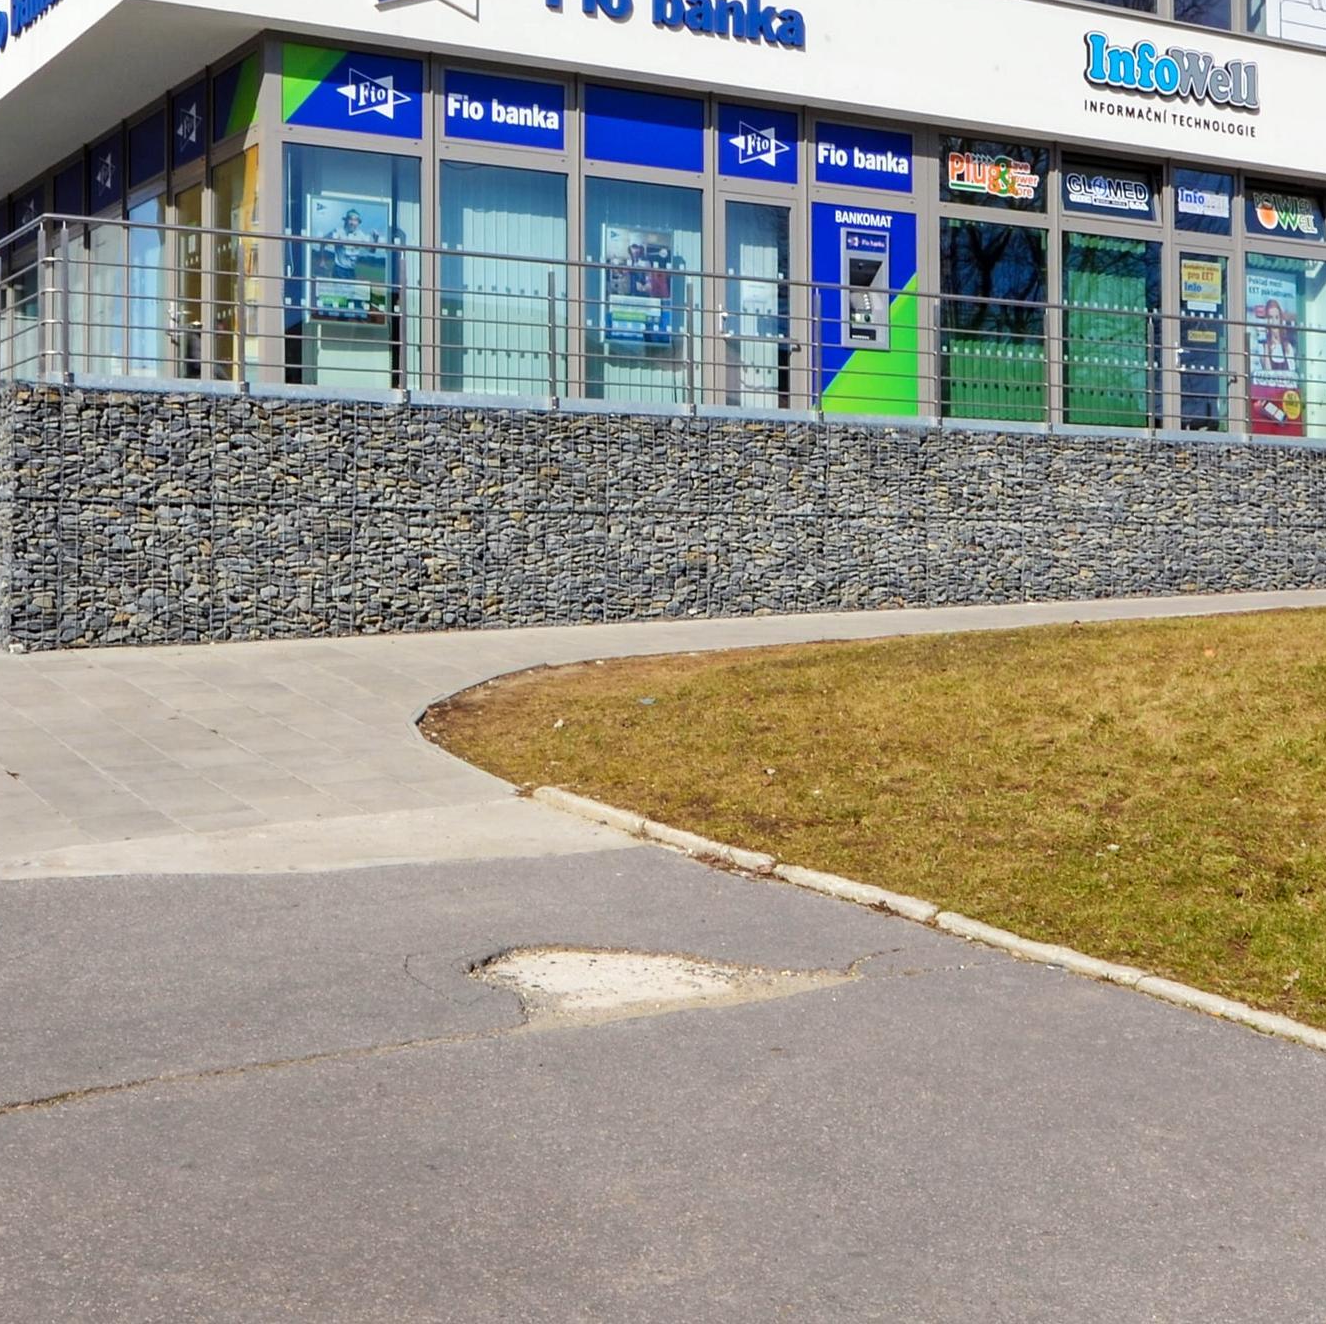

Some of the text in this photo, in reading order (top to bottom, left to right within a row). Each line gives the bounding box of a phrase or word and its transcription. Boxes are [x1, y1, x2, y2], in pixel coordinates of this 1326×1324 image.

[1086, 31, 1260, 109] InfoWell
[358, 81, 386, 107] Fio
[447, 92, 560, 130] Fio banka
[1084, 99, 1257, 138] INFORMAČNÍ TECHNOLOGIE
[746, 132, 770, 155] Fio
[817, 142, 909, 175] Fio banka
[835, 210, 893, 228] BANKOMAT
